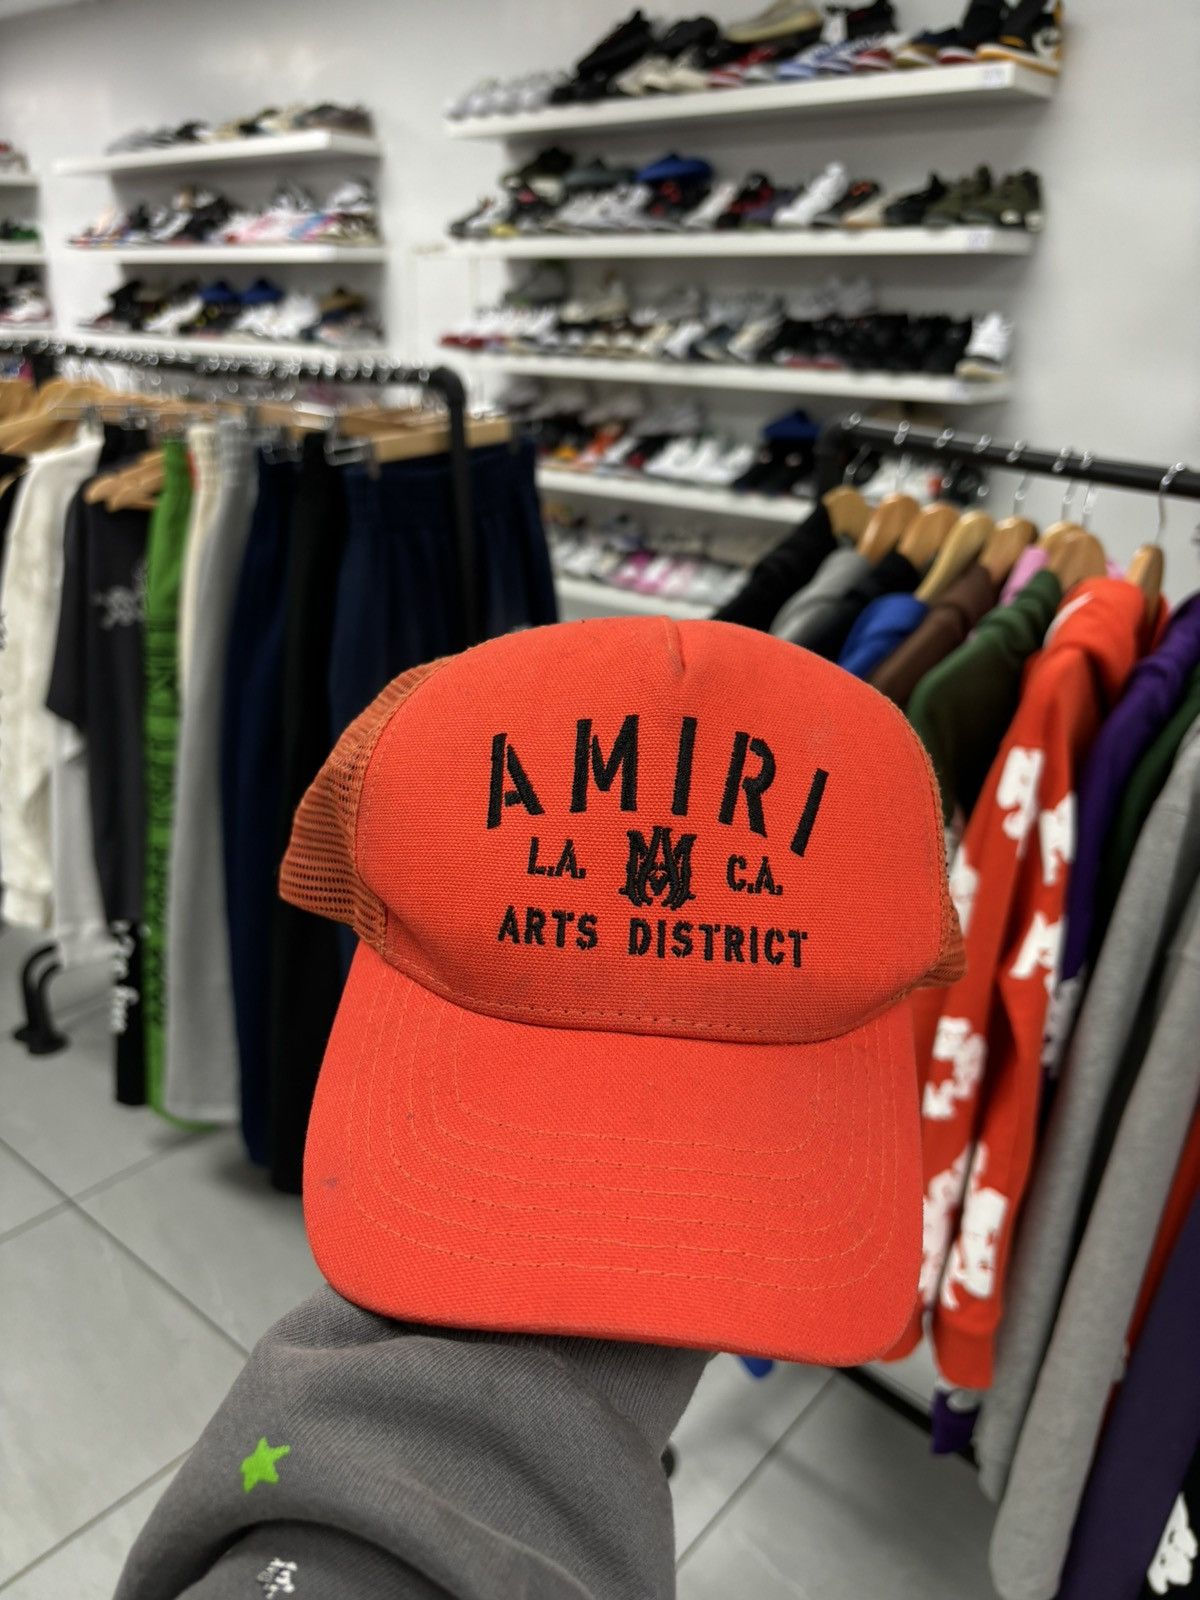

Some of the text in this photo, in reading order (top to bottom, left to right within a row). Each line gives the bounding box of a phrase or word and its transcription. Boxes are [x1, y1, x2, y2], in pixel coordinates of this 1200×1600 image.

[486, 714, 829, 857] AMIRI
[527, 837, 783, 895] L.A. C.A.
[498, 905, 808, 968] ARTS DISTRICT
